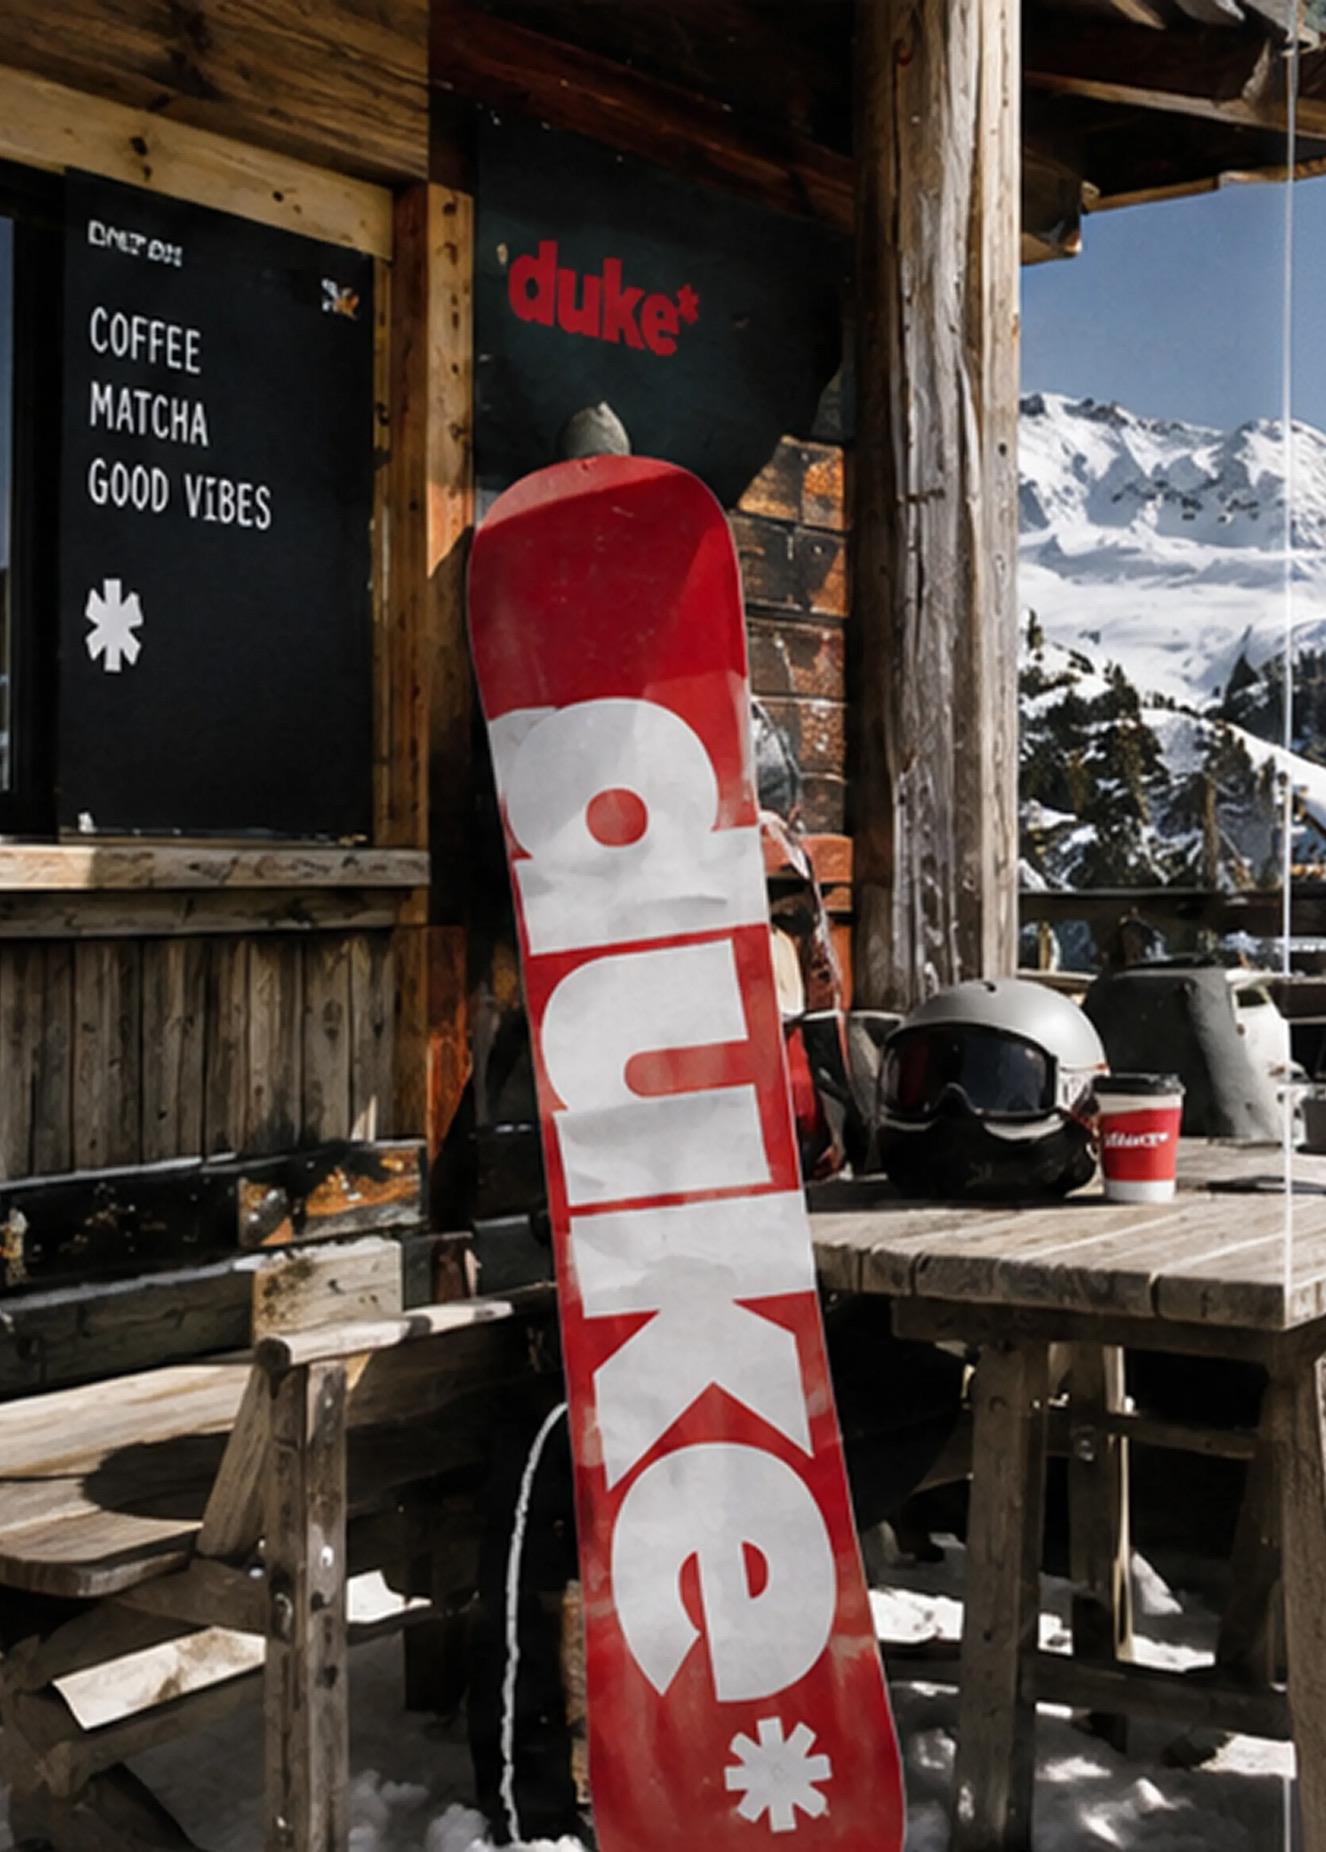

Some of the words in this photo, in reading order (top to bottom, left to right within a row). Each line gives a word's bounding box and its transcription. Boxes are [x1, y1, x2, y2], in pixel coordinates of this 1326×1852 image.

[90, 306, 201, 374] COFFEE
[90, 381, 209, 447] MATCHA
[88, 457, 169, 513] GOOD
[185, 473, 272, 531] VIBES
